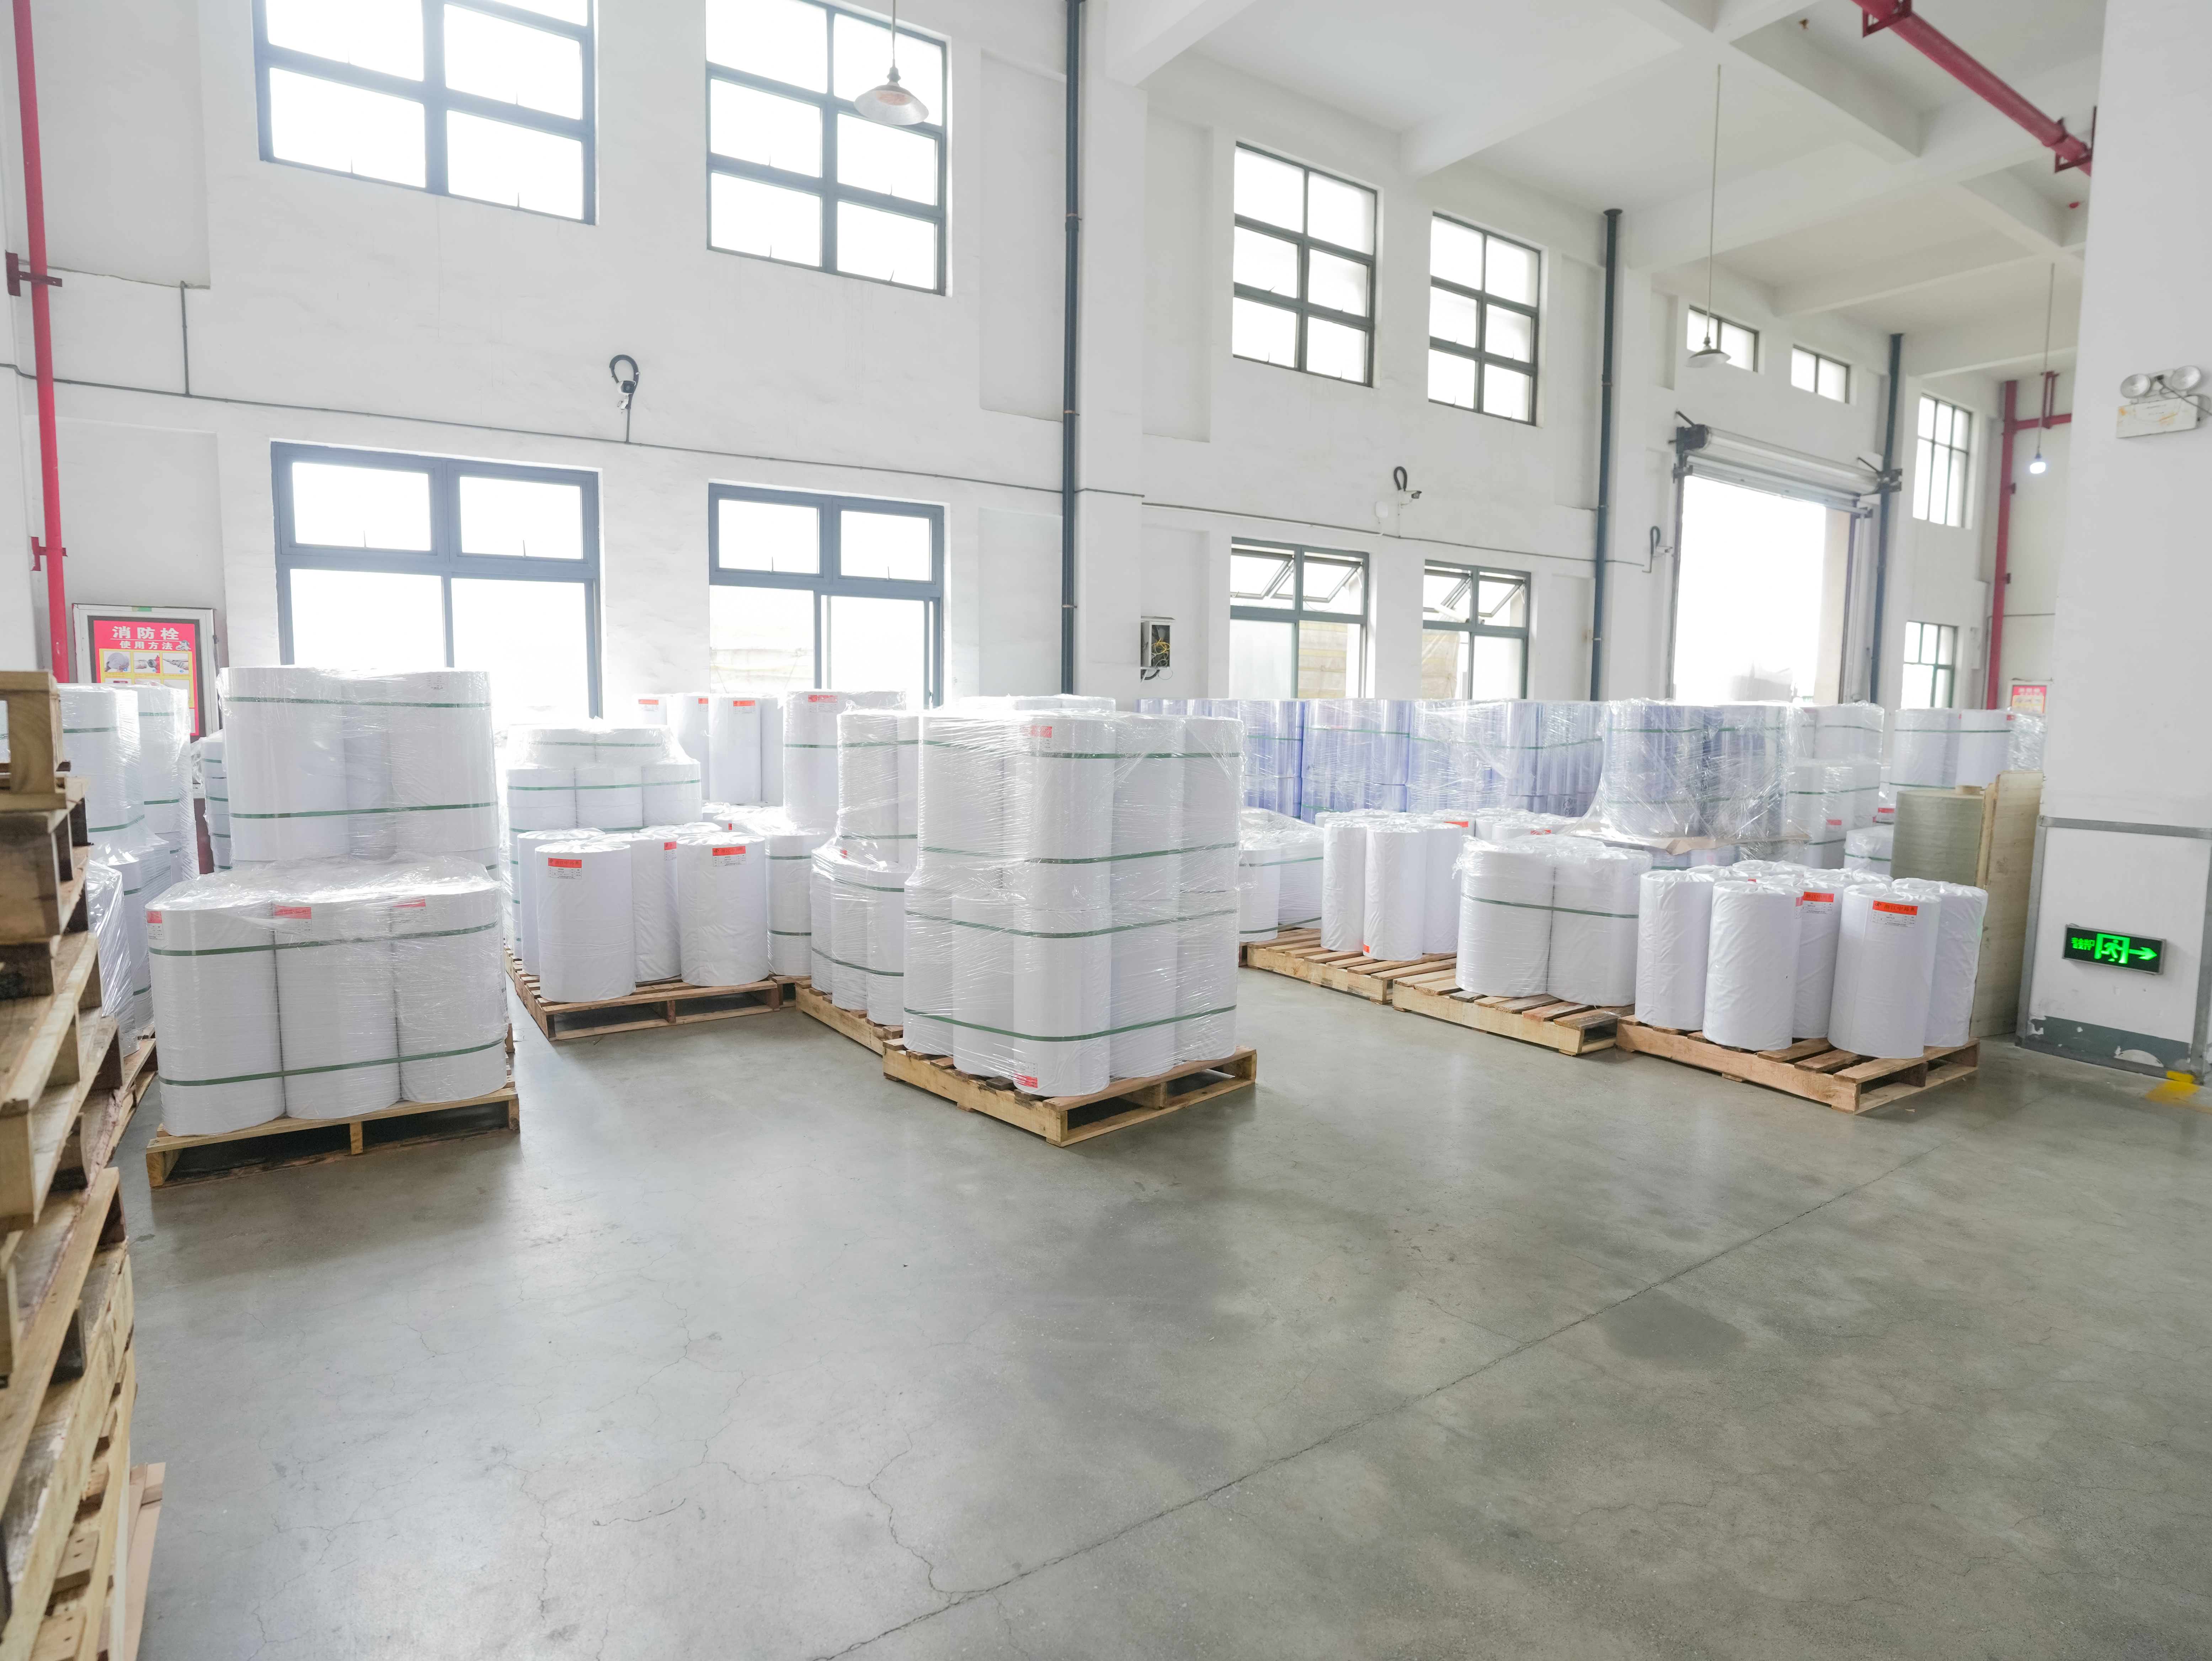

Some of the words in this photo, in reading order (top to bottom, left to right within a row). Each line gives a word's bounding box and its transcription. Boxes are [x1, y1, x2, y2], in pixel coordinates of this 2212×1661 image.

[112, 626, 179, 640] 消防栓
[119, 641, 173, 650] 使用方法
[2071, 937, 2095, 946] 安全出口
